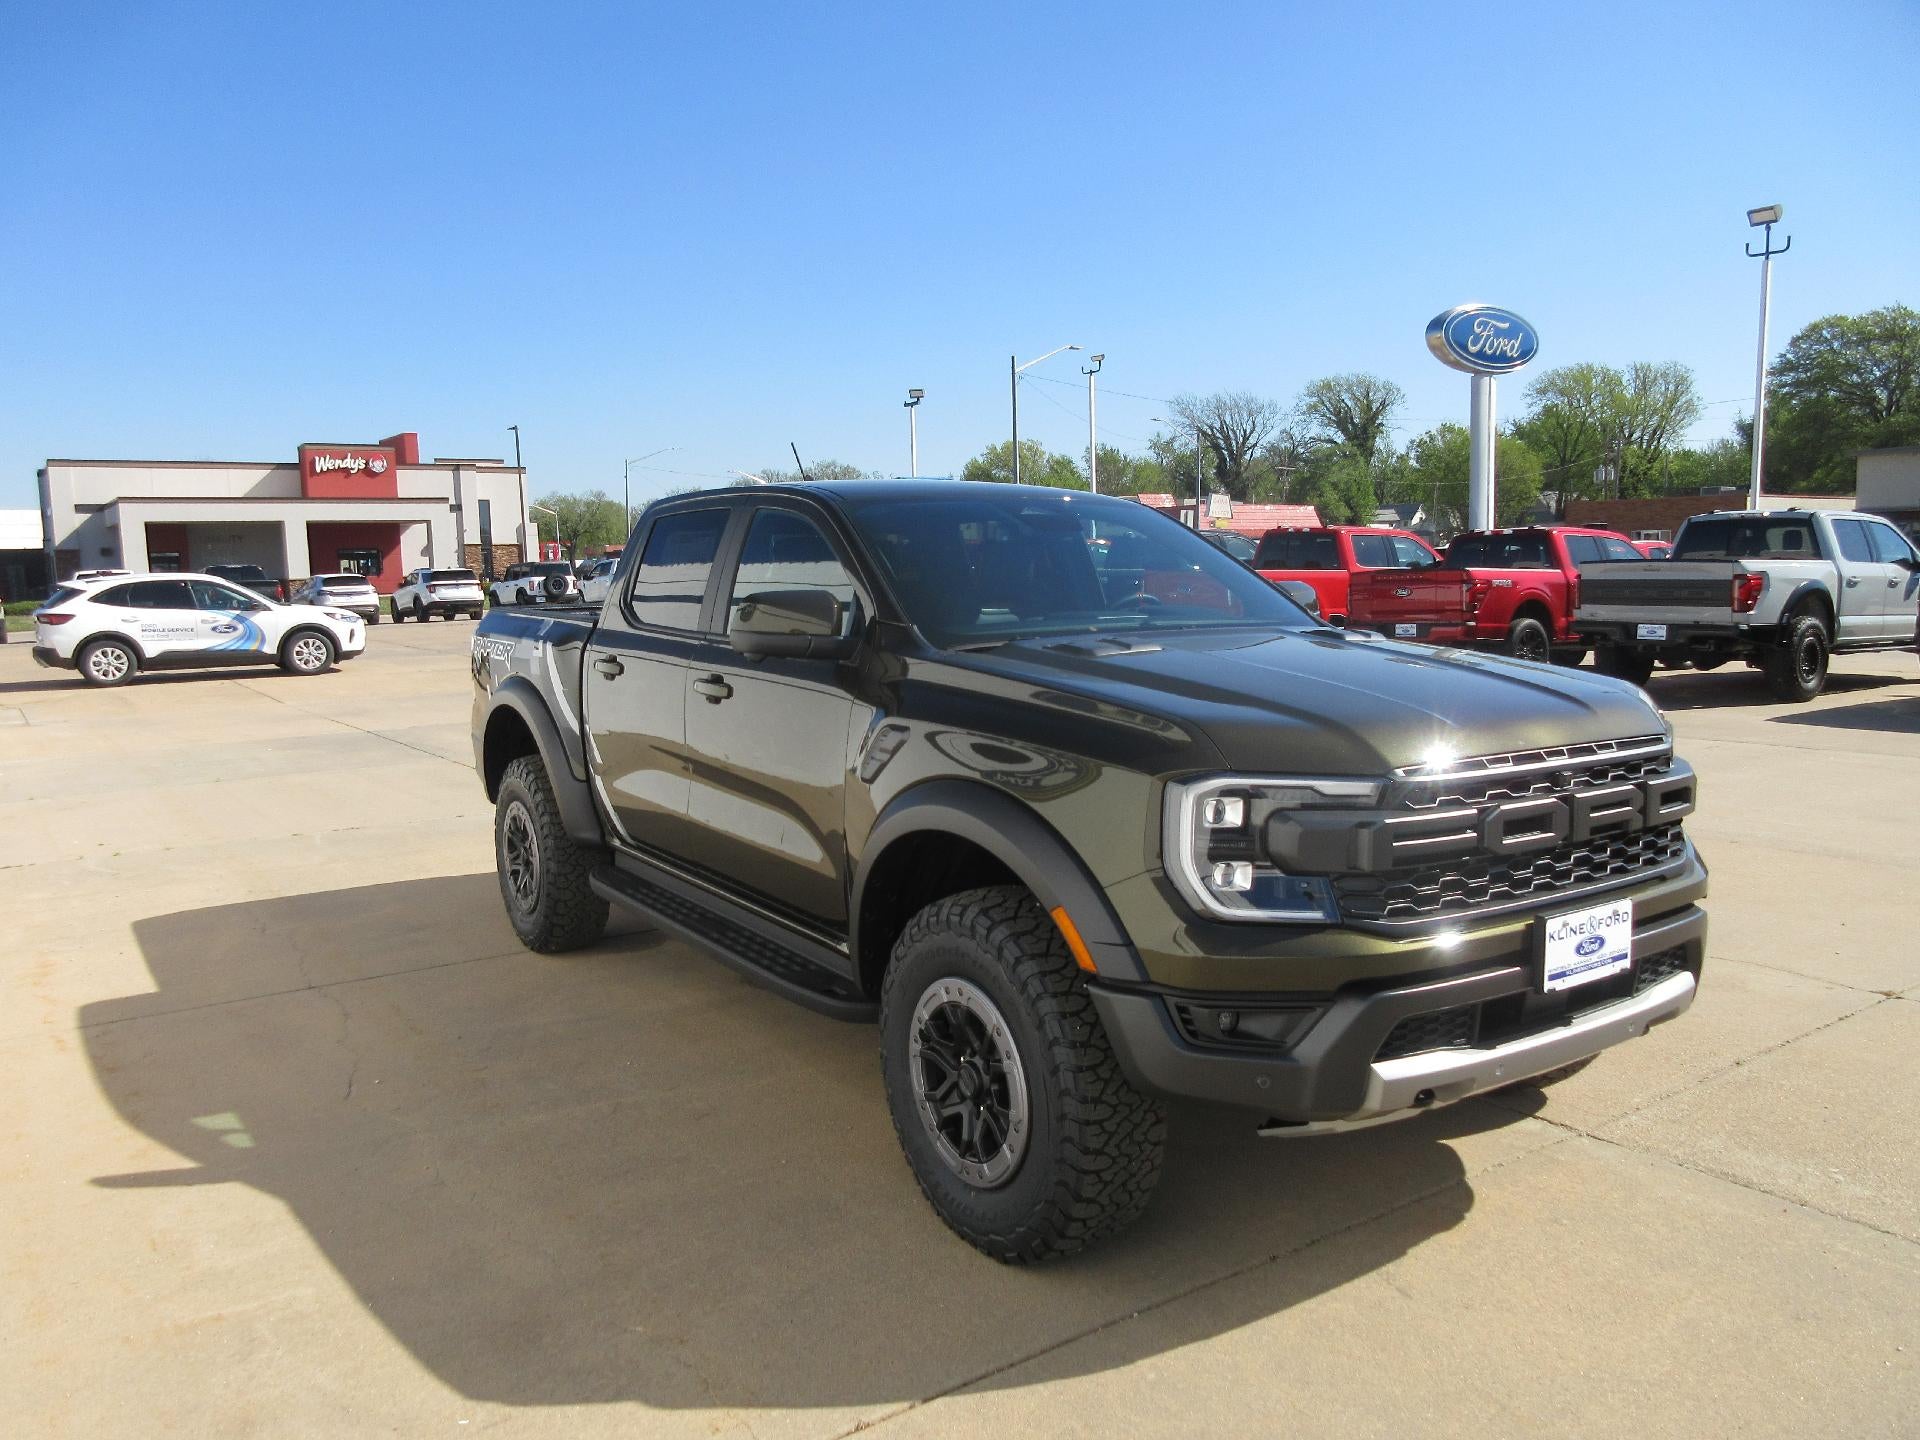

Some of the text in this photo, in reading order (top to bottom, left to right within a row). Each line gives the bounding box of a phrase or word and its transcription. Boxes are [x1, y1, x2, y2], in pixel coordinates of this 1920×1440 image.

[1467, 317, 1523, 358] Ford
[314, 452, 366, 474] Wendy's
[473, 636, 515, 671] RAPTOR
[1360, 769, 1697, 872] FORD
[1548, 923, 1586, 943] KLINE
[1597, 911, 1629, 929] FORD
[1579, 938, 1602, 954] Ford
